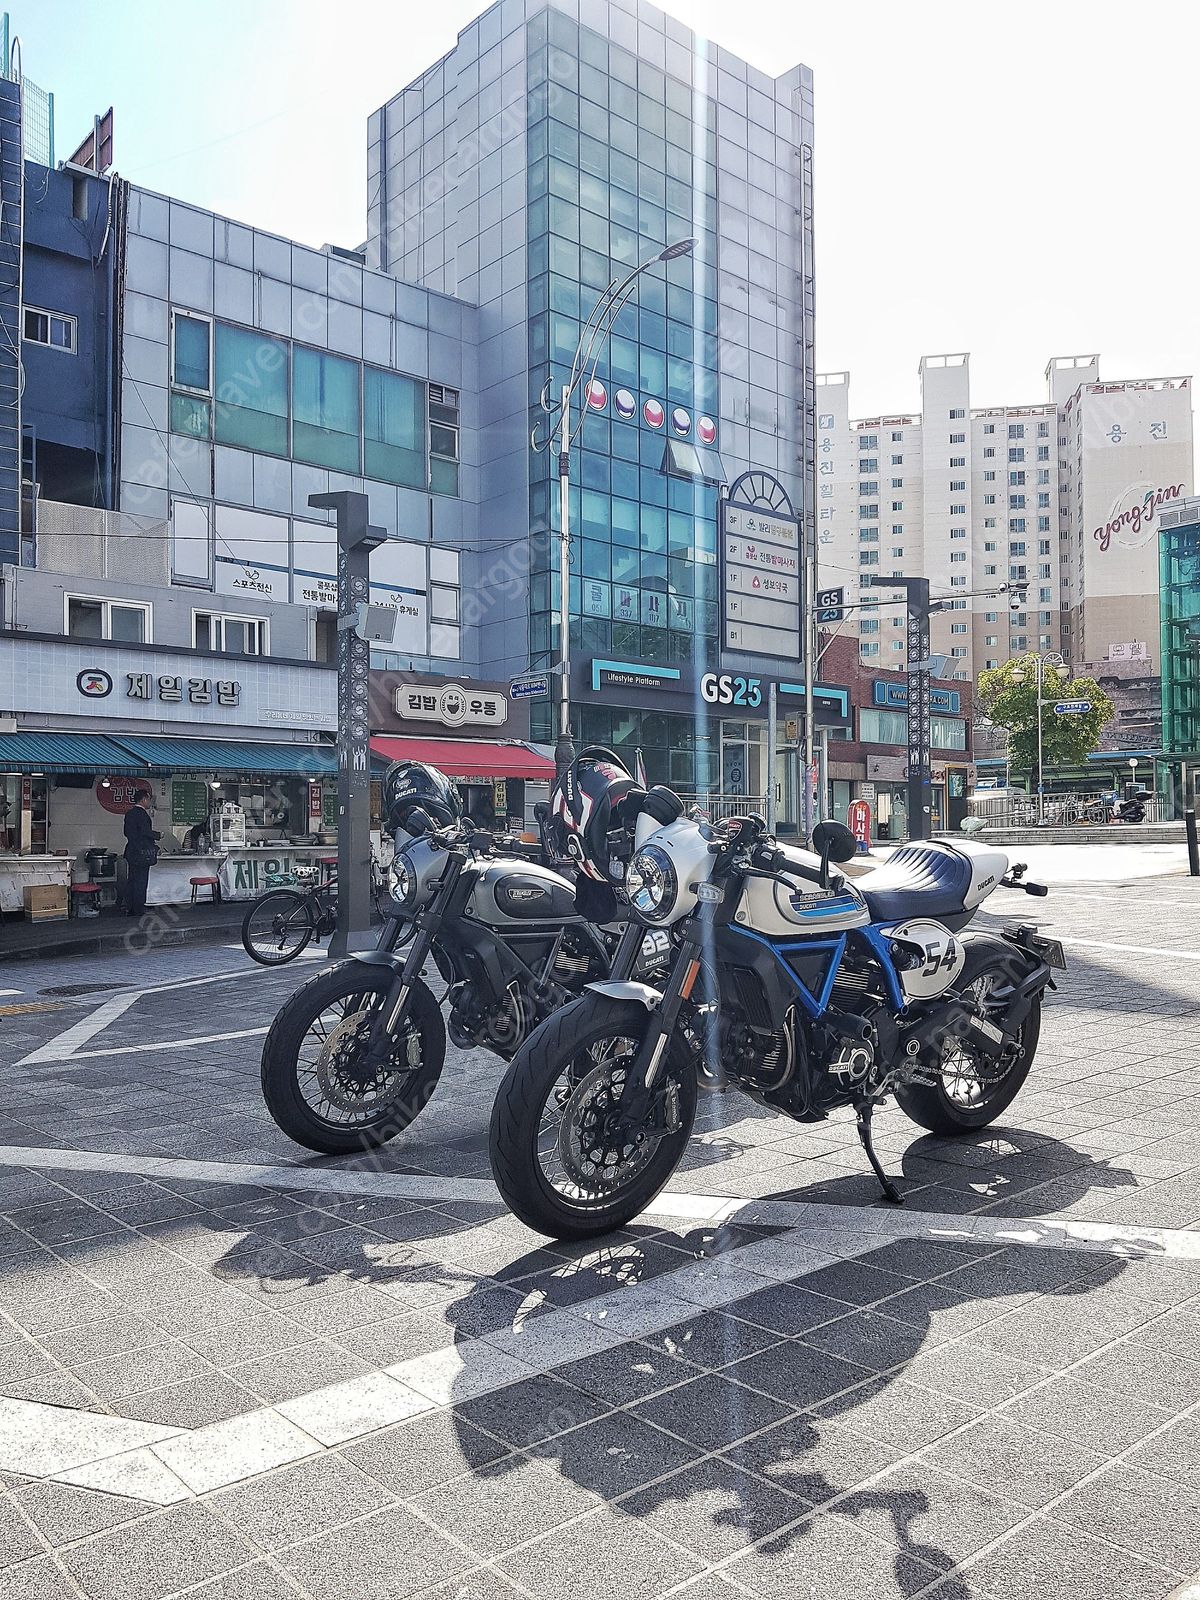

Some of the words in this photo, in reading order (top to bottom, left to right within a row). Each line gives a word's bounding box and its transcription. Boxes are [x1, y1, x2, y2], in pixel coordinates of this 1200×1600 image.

[729, 515, 738, 524] 3F
[729, 544, 738, 553] 2F
[759, 551, 796, 569] 전통발마사지
[729, 573, 738, 582] 1F
[232, 577, 273, 594] 스포츠전신
[762, 578, 789, 594] 성보약국
[301, 588, 338, 604] 전통발마
[821, 592, 838, 606] GS
[399, 604, 419, 617] 휴게실
[729, 601, 738, 611] 1F
[730, 630, 738, 640] B1
[607, 673, 634, 684] Lifestyle
[635, 676, 661, 687] Platform
[127, 672, 242, 707] 제일김밥
[701, 672, 762, 708] GS25
[407, 694, 437, 712] 김밥
[470, 700, 497, 717] 우동
[311, 787, 321, 810] 김밥
[394, 787, 417, 801] DUCATI
[496, 783, 505, 802] 김밥
[977, 874, 996, 891] DUCATI
[799, 902, 817, 910] DUCATI
[645, 955, 664, 967] DUCATI
[922, 940, 958, 977] 54
